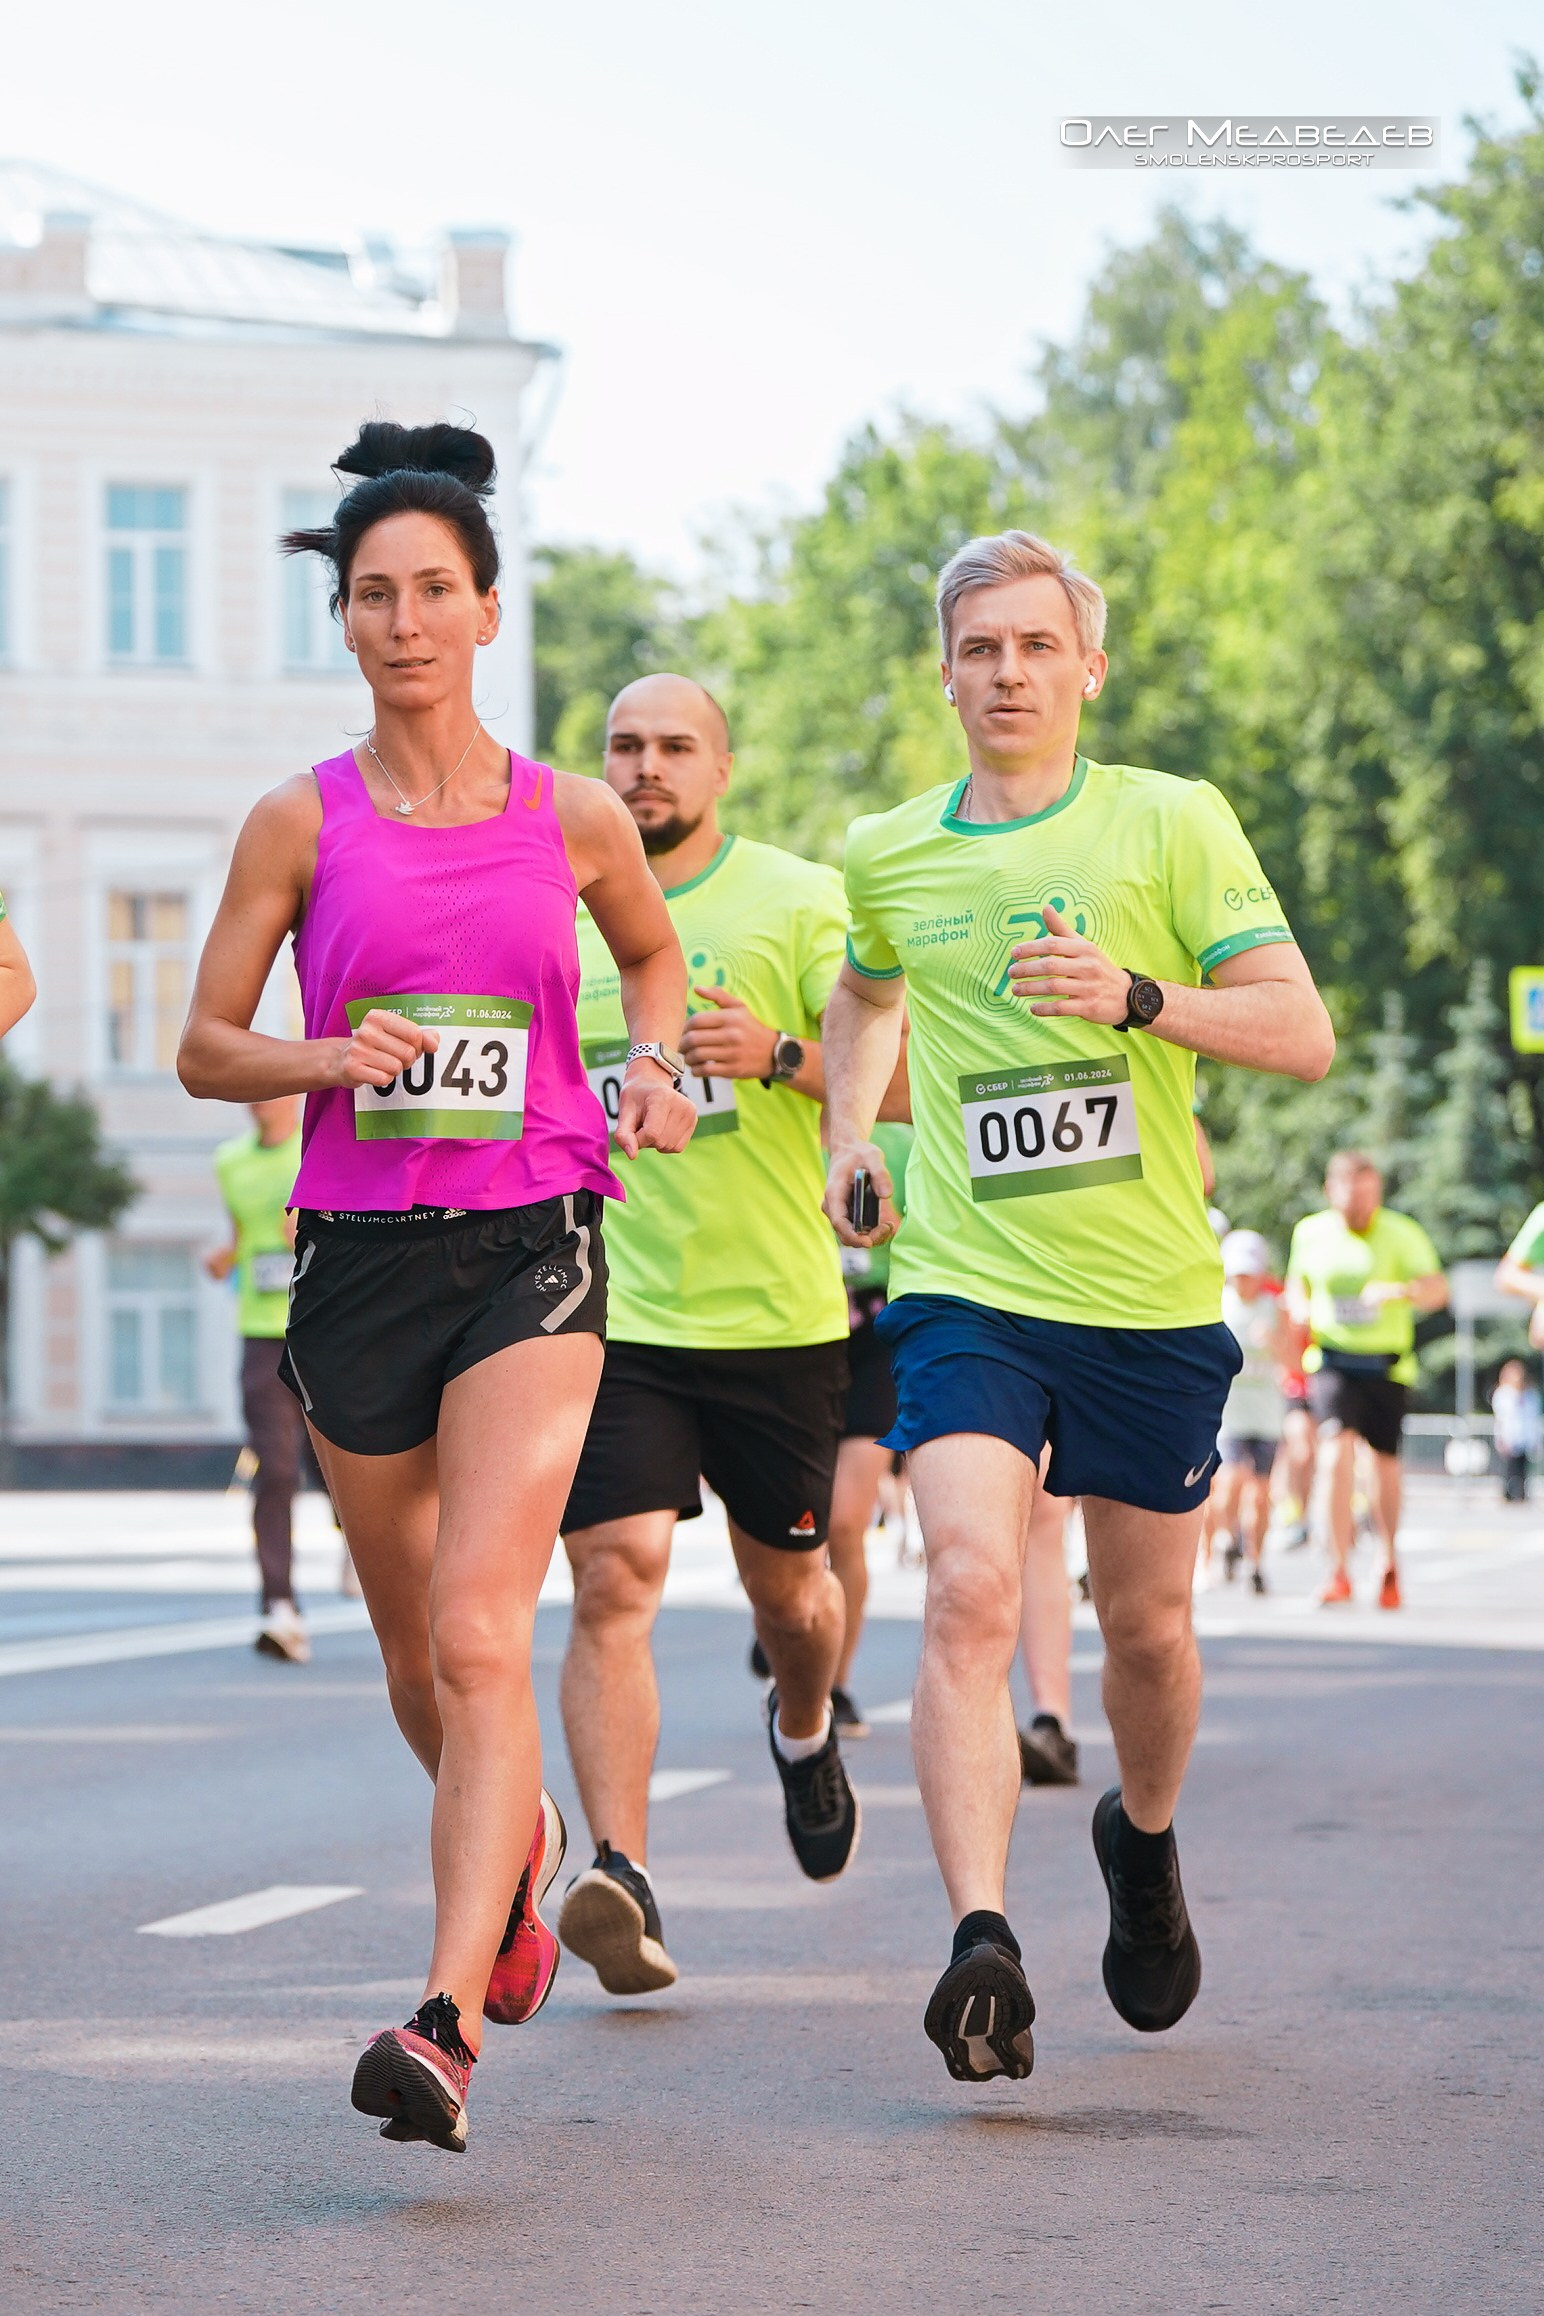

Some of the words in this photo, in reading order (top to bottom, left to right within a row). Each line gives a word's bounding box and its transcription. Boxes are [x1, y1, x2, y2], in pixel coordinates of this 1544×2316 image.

[912, 909, 974, 932] зелёный
[907, 928, 969, 948] марафон
[466, 1008, 512, 1019] 01.06.2024
[373, 1040, 508, 1097] 043
[986, 1082, 1008, 1092] СБЕР
[1064, 1069, 1112, 1082] 01.06.2024
[979, 1095, 1118, 1163] 0067
[443, 1210, 467, 1220] adidas
